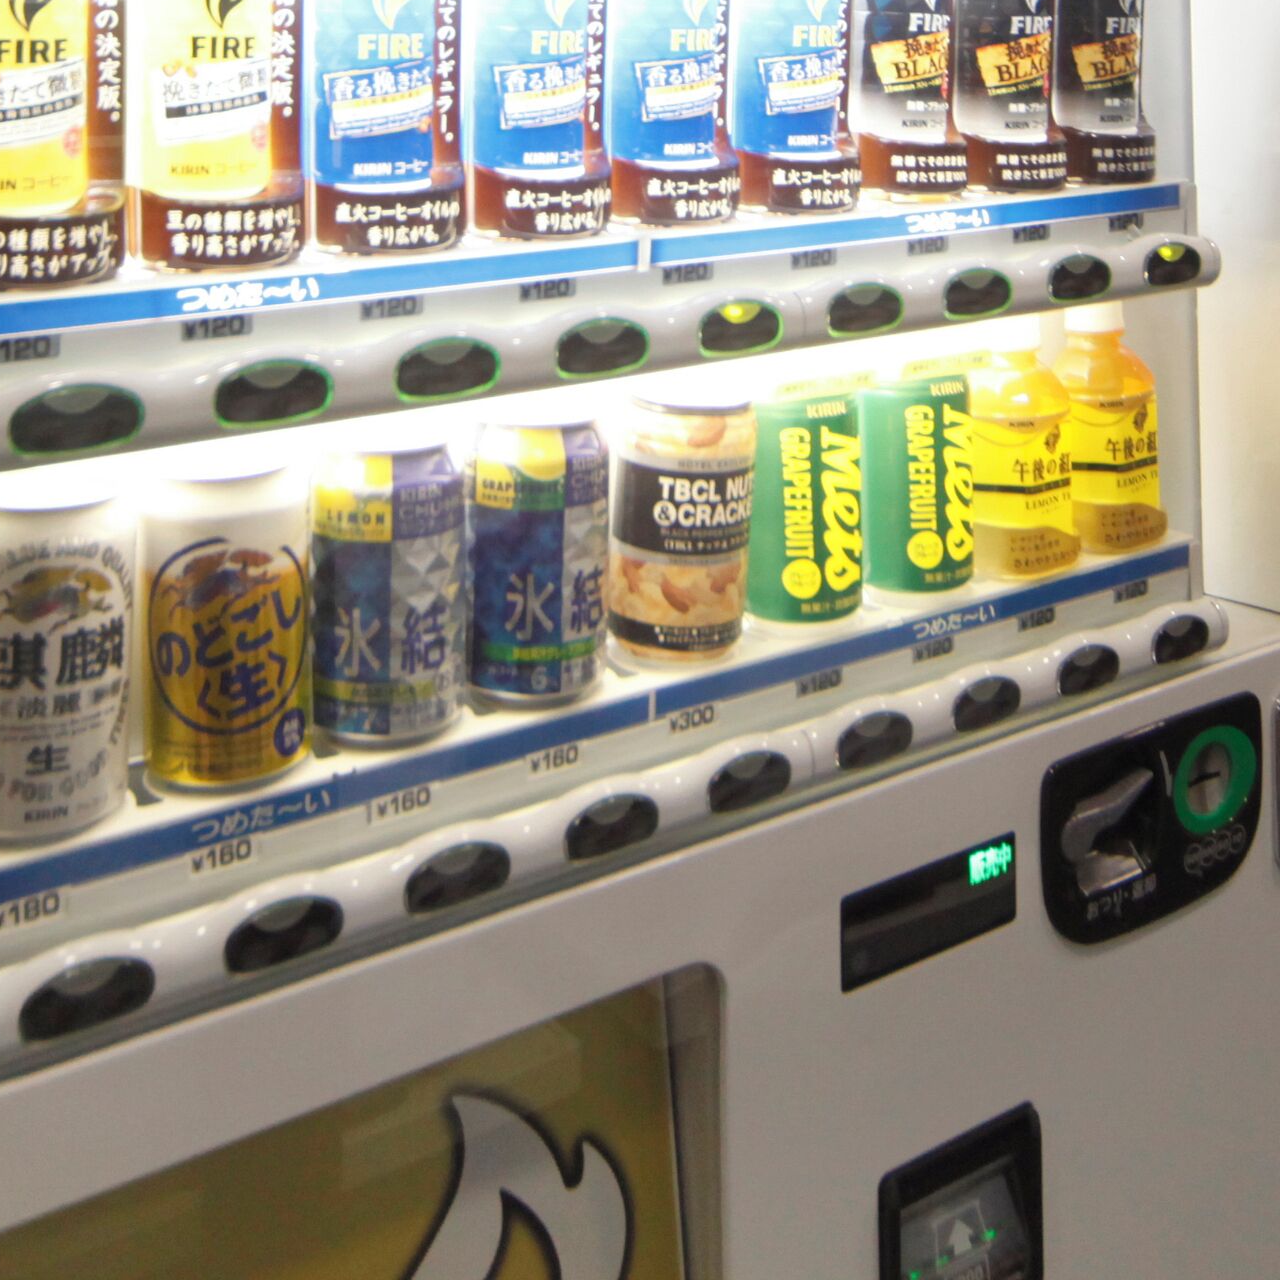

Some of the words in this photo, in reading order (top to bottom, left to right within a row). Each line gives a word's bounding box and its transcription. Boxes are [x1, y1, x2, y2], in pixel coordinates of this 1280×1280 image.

[191, 36, 255, 59] FIRE
[357, 33, 423, 59] FIRE
[531, 29, 584, 54] FIRE
[171, 163, 210, 175] KIRIN
[523, 152, 557, 164] KIRIN
[354, 163, 391, 176] KIRIN
[520, 279, 570, 299] ¥120
[362, 298, 416, 318] ¥120
[184, 318, 246, 339] ¥120
[930, 382, 964, 396] KIRIN
[806, 401, 846, 418] KIRIN
[905, 405, 937, 531] GRAPEFRUIT
[658, 475, 721, 502] TBCL
[1117, 473, 1147, 488] LEMON
[780, 427, 815, 559] GRAPEFRUIT
[1026, 495, 1059, 510] LEMON
[327, 509, 387, 525] LEMON
[505, 566, 607, 641] 氷結
[156, 590, 302, 678] のどごし
[335, 607, 449, 677] 氷結
[669, 705, 715, 732] ¥300
[26, 744, 70, 776] 生
